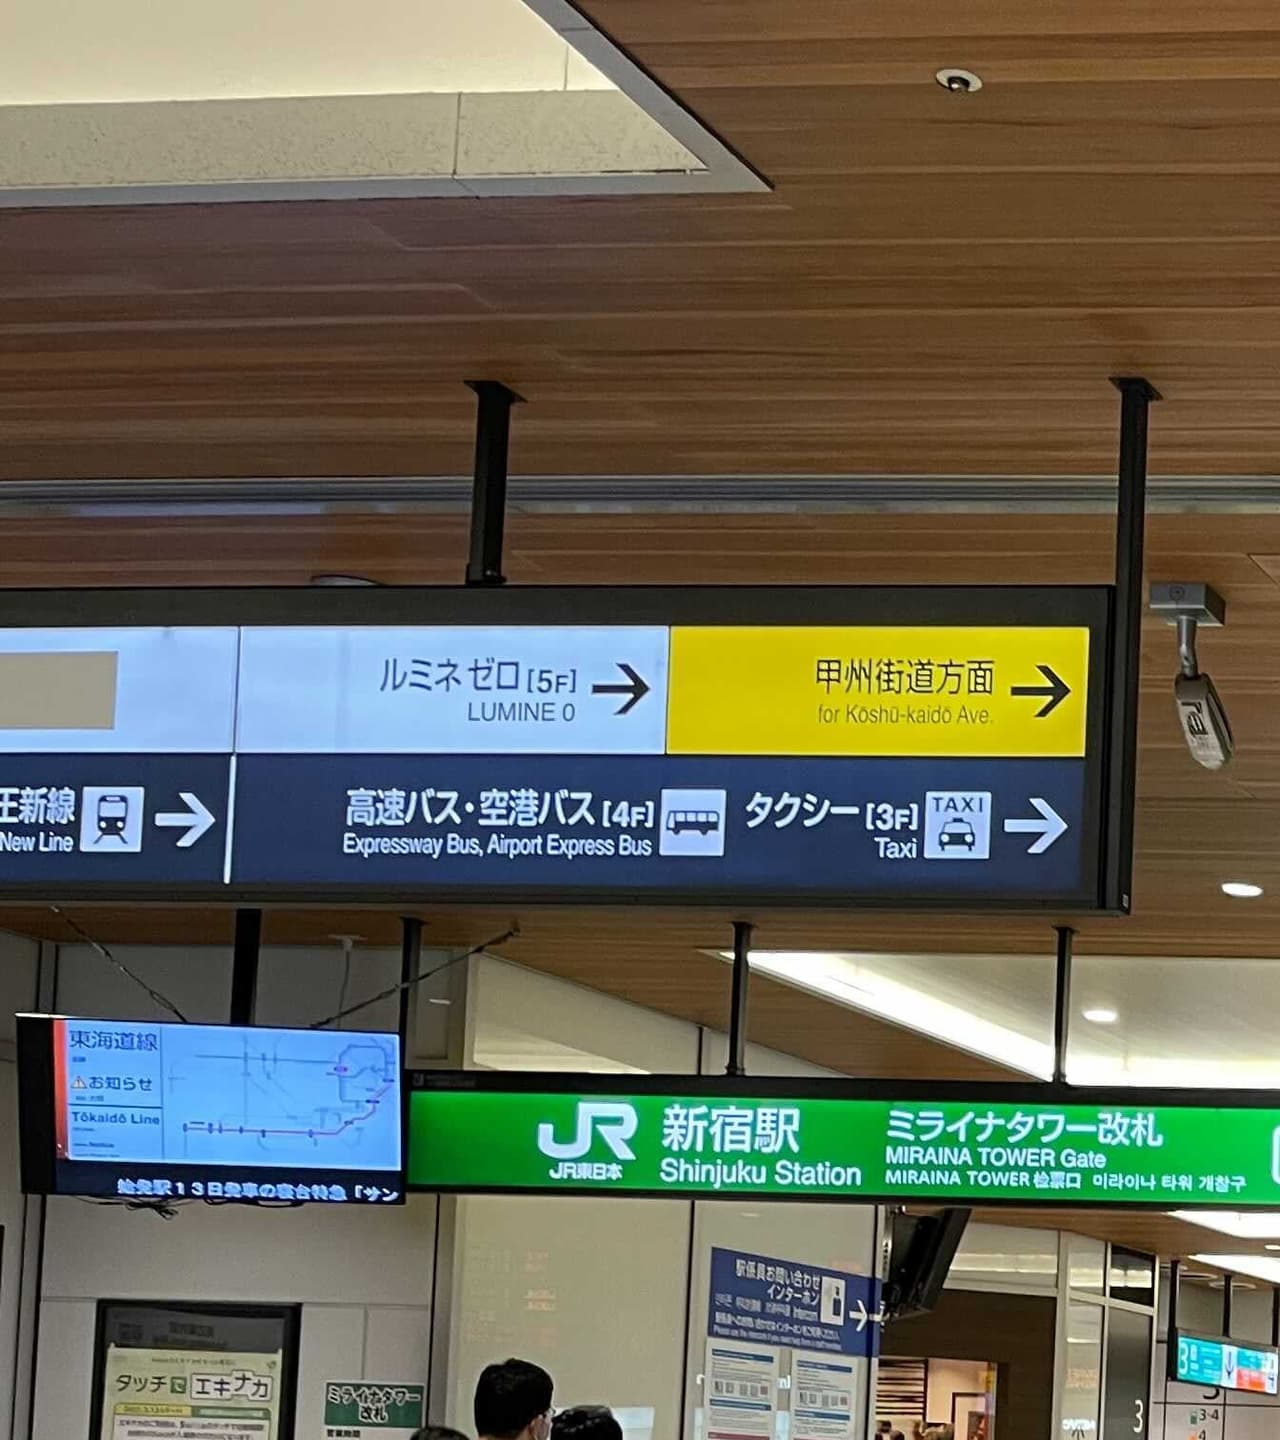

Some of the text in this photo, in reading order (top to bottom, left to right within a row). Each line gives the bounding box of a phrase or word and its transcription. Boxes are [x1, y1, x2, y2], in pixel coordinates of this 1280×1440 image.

[815, 658, 995, 696] 甲州街道方面
[468, 703, 555, 722] LUMINE
[818, 706, 840, 723] for
[957, 707, 994, 724] Ave.
[0, 787, 76, 824] 王新線
[746, 792, 860, 828] タクシー
[933, 797, 984, 813] TAXI
[0, 831, 74, 852] New Line
[343, 834, 652, 858] Expressway Bus, Airport Express Bus
[875, 838, 917, 859] Taxi
[69, 1029, 158, 1052] 東海道線
[89, 1076, 153, 1093] お知らせ
[131, 1113, 160, 1127] Line
[537, 1102, 638, 1160] JR
[662, 1104, 800, 1154] 新宿駅
[887, 1110, 1163, 1147] ミライナタワー改札
[885, 1146, 1106, 1169] MIRAINA TOWER Gate
[549, 1162, 623, 1181] JR東日本
[660, 1158, 862, 1188] Shinjuku Station
[885, 1171, 961, 1186] MIRAINA
[966, 1172, 1030, 1187] TOWER
[1093, 1172, 1157, 1191] 미라이나
[1161, 1174, 1193, 1191] 타워
[1133, 1399, 1144, 1433] 3
